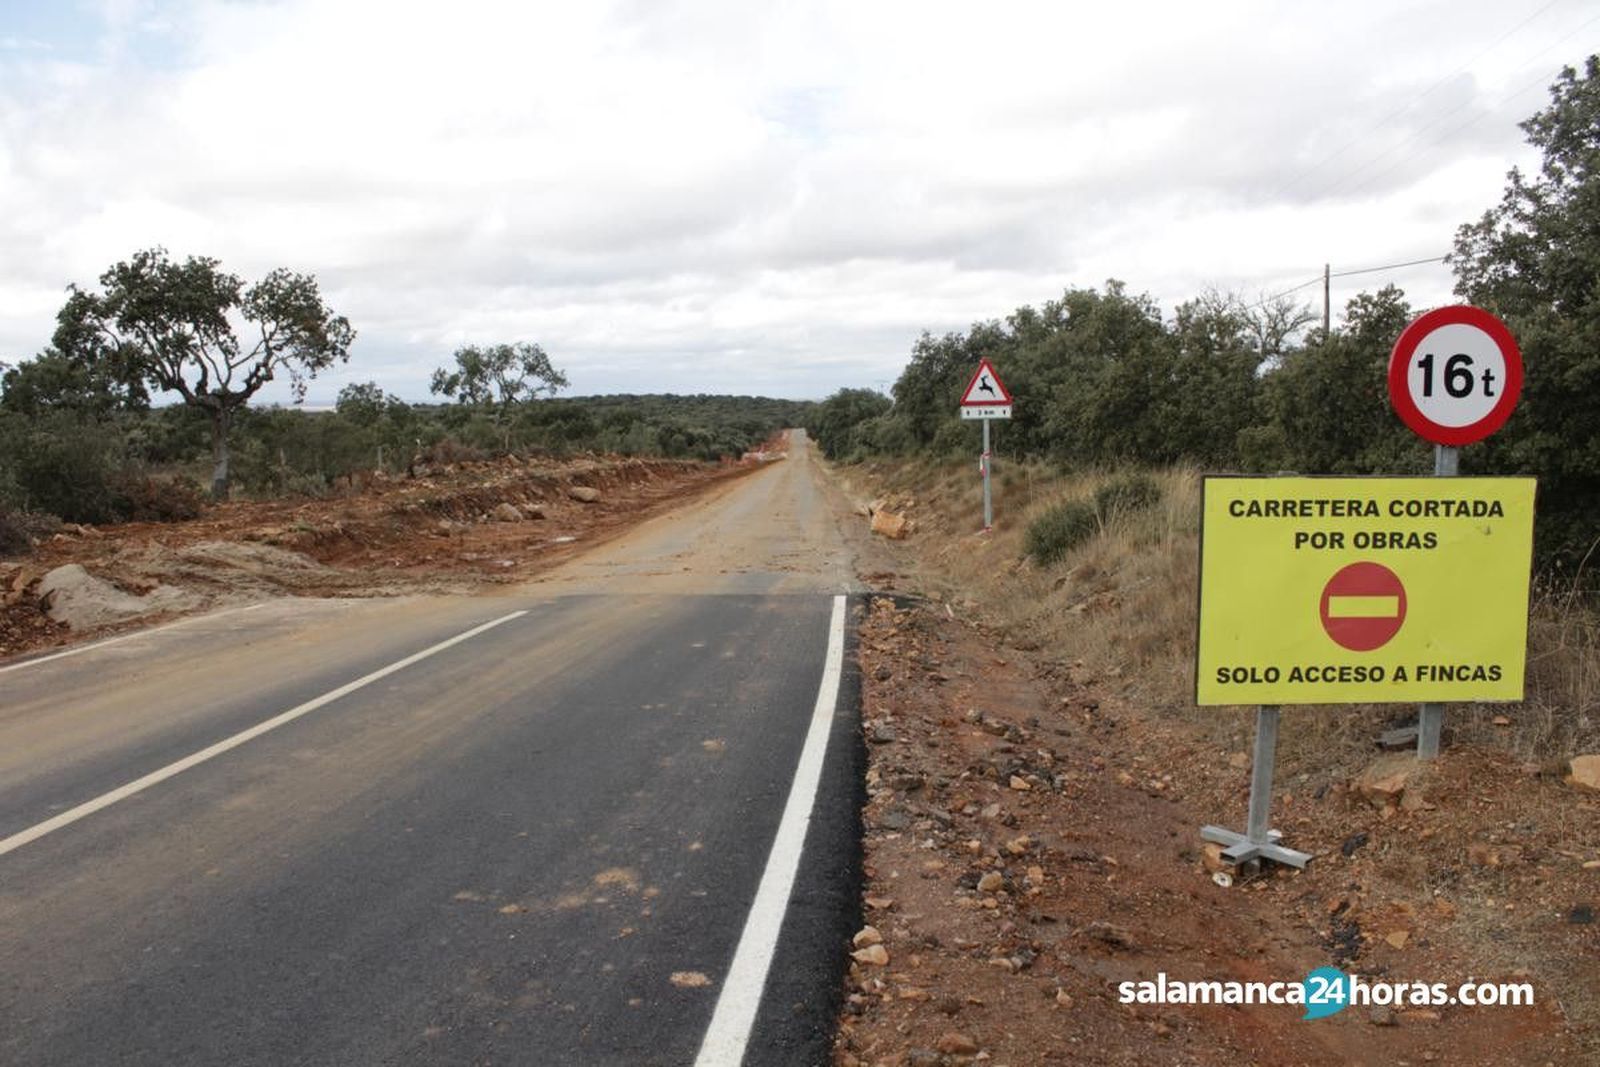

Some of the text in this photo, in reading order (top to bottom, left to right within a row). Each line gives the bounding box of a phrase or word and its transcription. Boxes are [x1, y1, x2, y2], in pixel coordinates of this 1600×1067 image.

[1228, 499, 1505, 518] CARRETERA CORTADA
[1294, 531, 1438, 550] POR OBRAS
[1216, 665, 1503, 684] SOLO ACCESO A FINCAS
